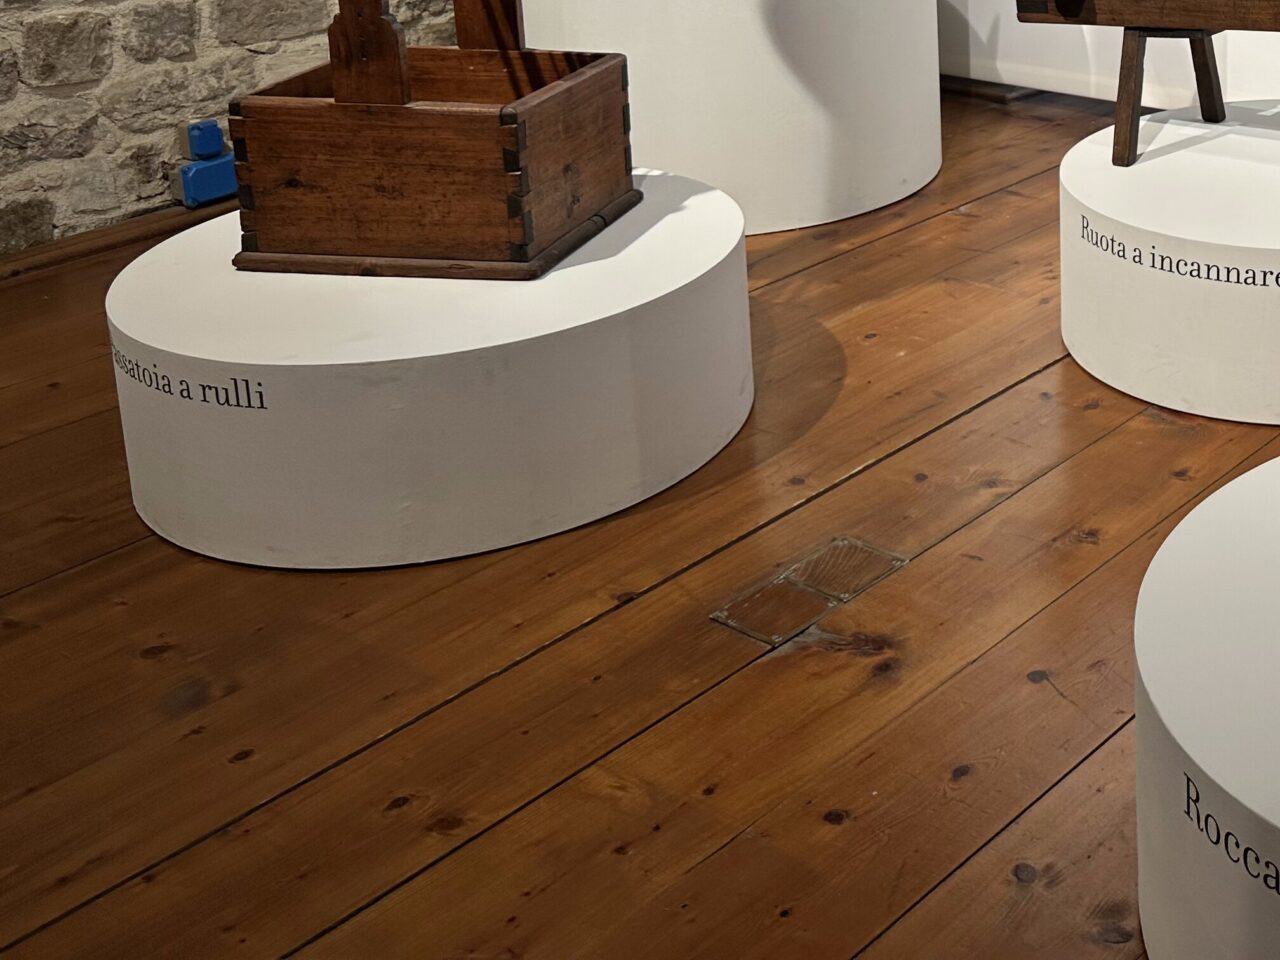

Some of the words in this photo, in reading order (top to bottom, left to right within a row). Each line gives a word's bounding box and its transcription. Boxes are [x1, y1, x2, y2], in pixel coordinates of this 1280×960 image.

[1080, 214, 1127, 260] Ruota
[1132, 247, 1144, 265] a
[111, 345, 174, 395] assatoia
[179, 379, 193, 400] a
[199, 378, 268, 410] rulli
